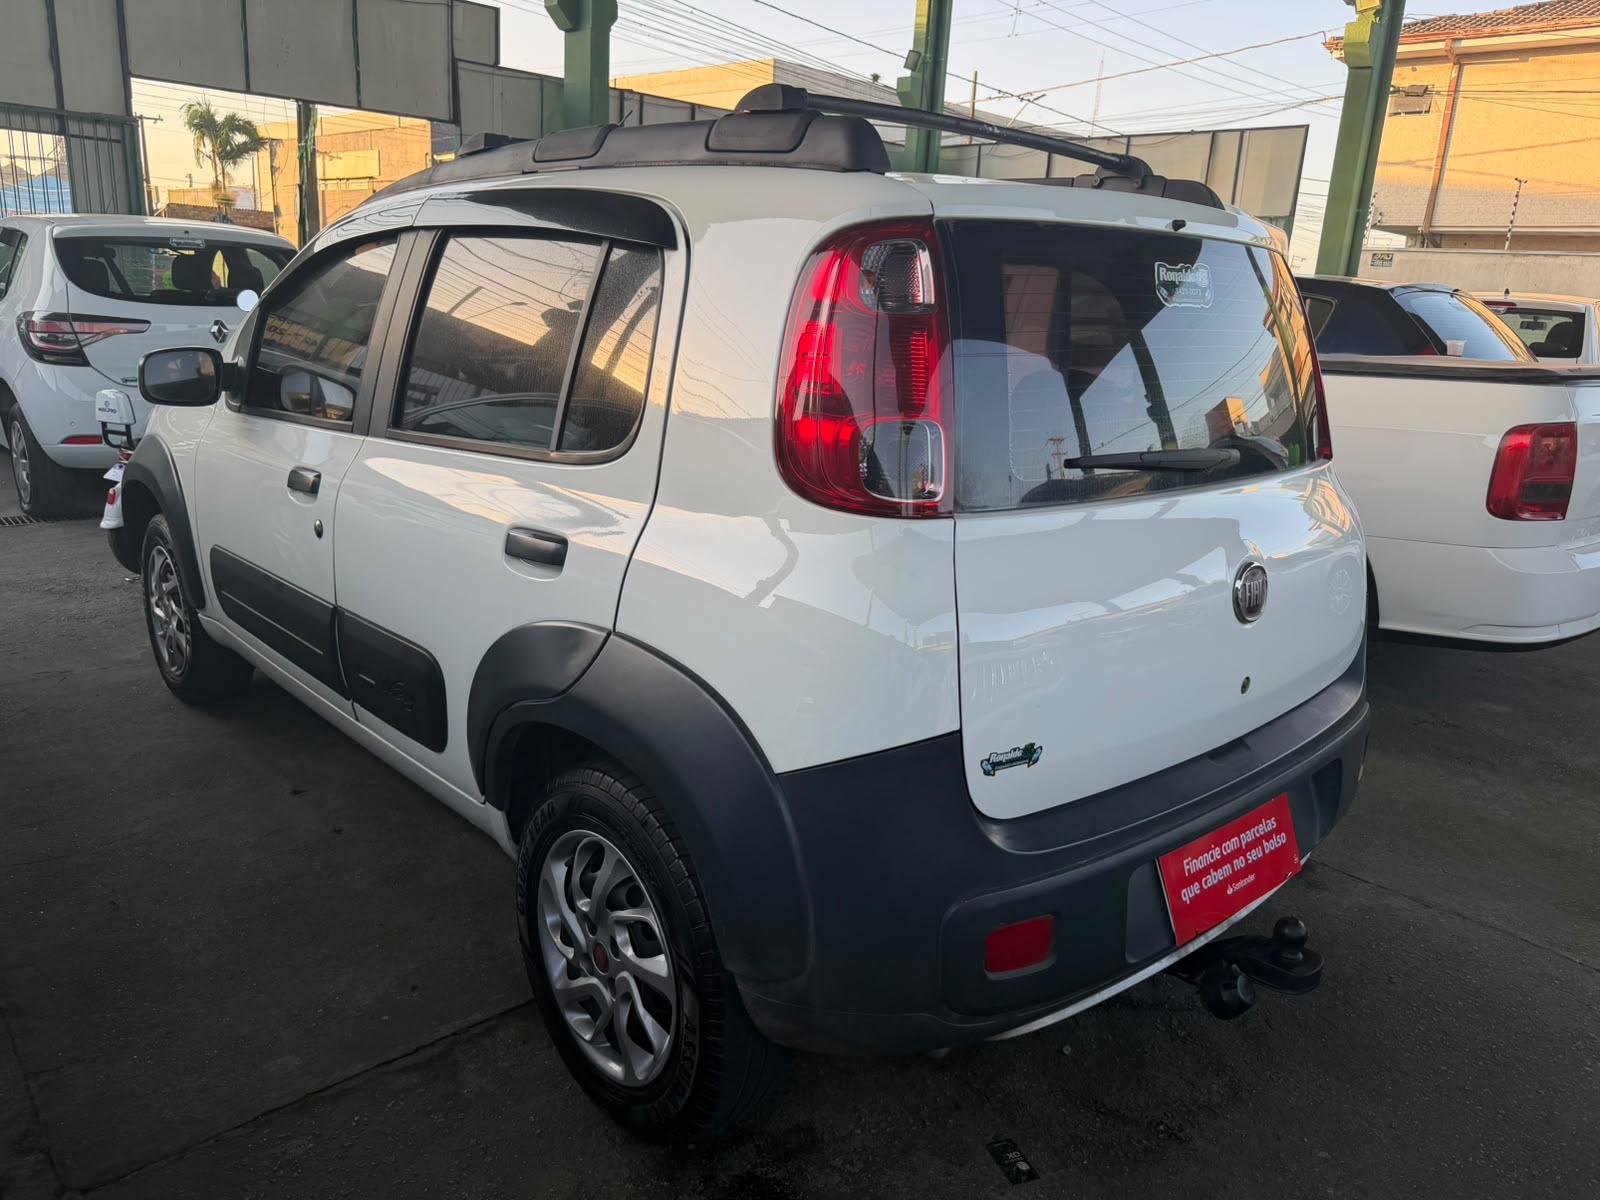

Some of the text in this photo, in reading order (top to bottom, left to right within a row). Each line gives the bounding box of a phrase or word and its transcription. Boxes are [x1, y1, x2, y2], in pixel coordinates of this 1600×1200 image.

[1159, 267, 1197, 285] Ronaldo
[1245, 579, 1263, 608] FIAT
[1183, 817, 1277, 877] Financie com parcelas
[1181, 832, 1287, 905] que cabem no seu bolso
[1232, 873, 1256, 892] Santander
